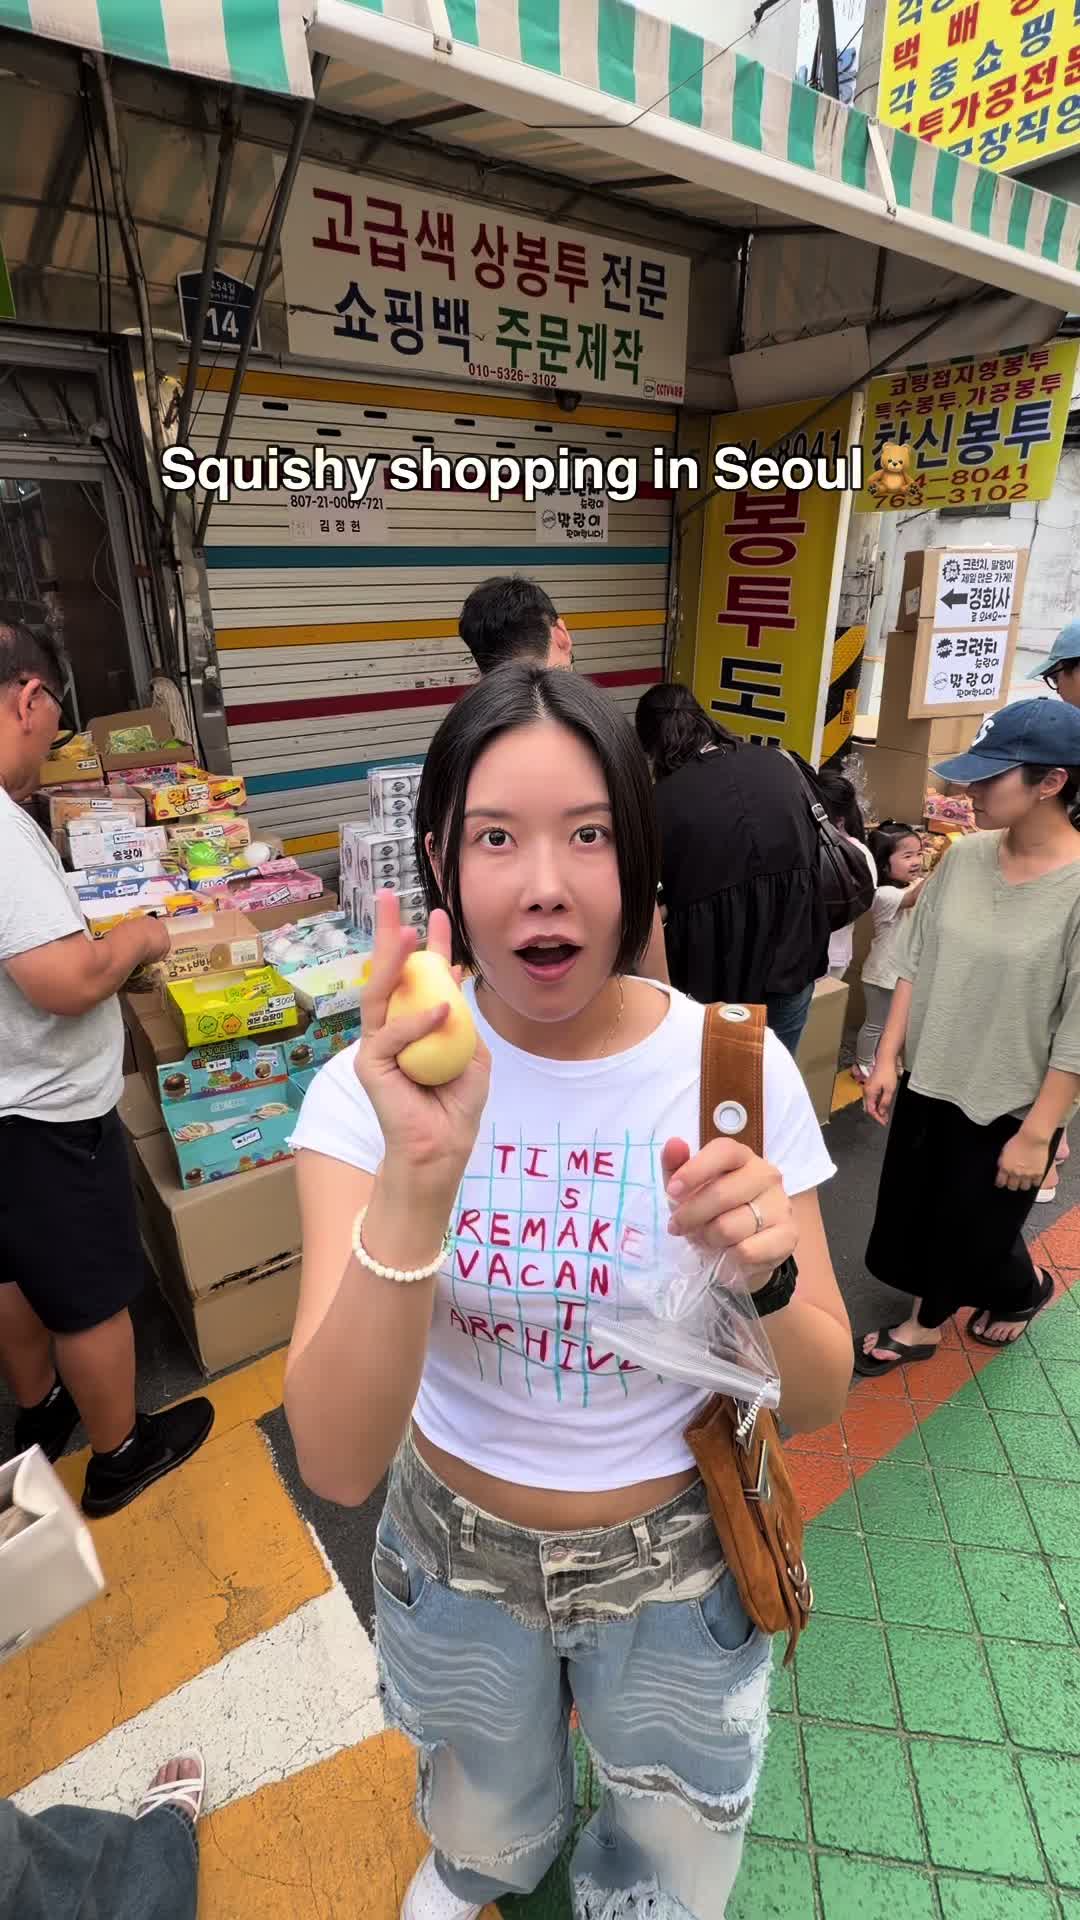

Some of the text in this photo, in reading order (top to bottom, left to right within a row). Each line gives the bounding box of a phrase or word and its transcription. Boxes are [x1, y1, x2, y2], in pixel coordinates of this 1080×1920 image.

[312, 187, 668, 320] 고급색 상봉투 전문
[206, 307, 239, 338] 14
[333, 281, 644, 385] 쇼핑백 주문제작
[468, 362, 558, 388] 010-5326-3102
[872, 483, 1029, 508] 763-3102
[969, 586, 1010, 610] 경화사
[954, 637, 997, 657] 크런치
[494, 1144, 615, 1178] TIME
[560, 1187, 581, 1209] S
[556, 1299, 586, 1331] T
